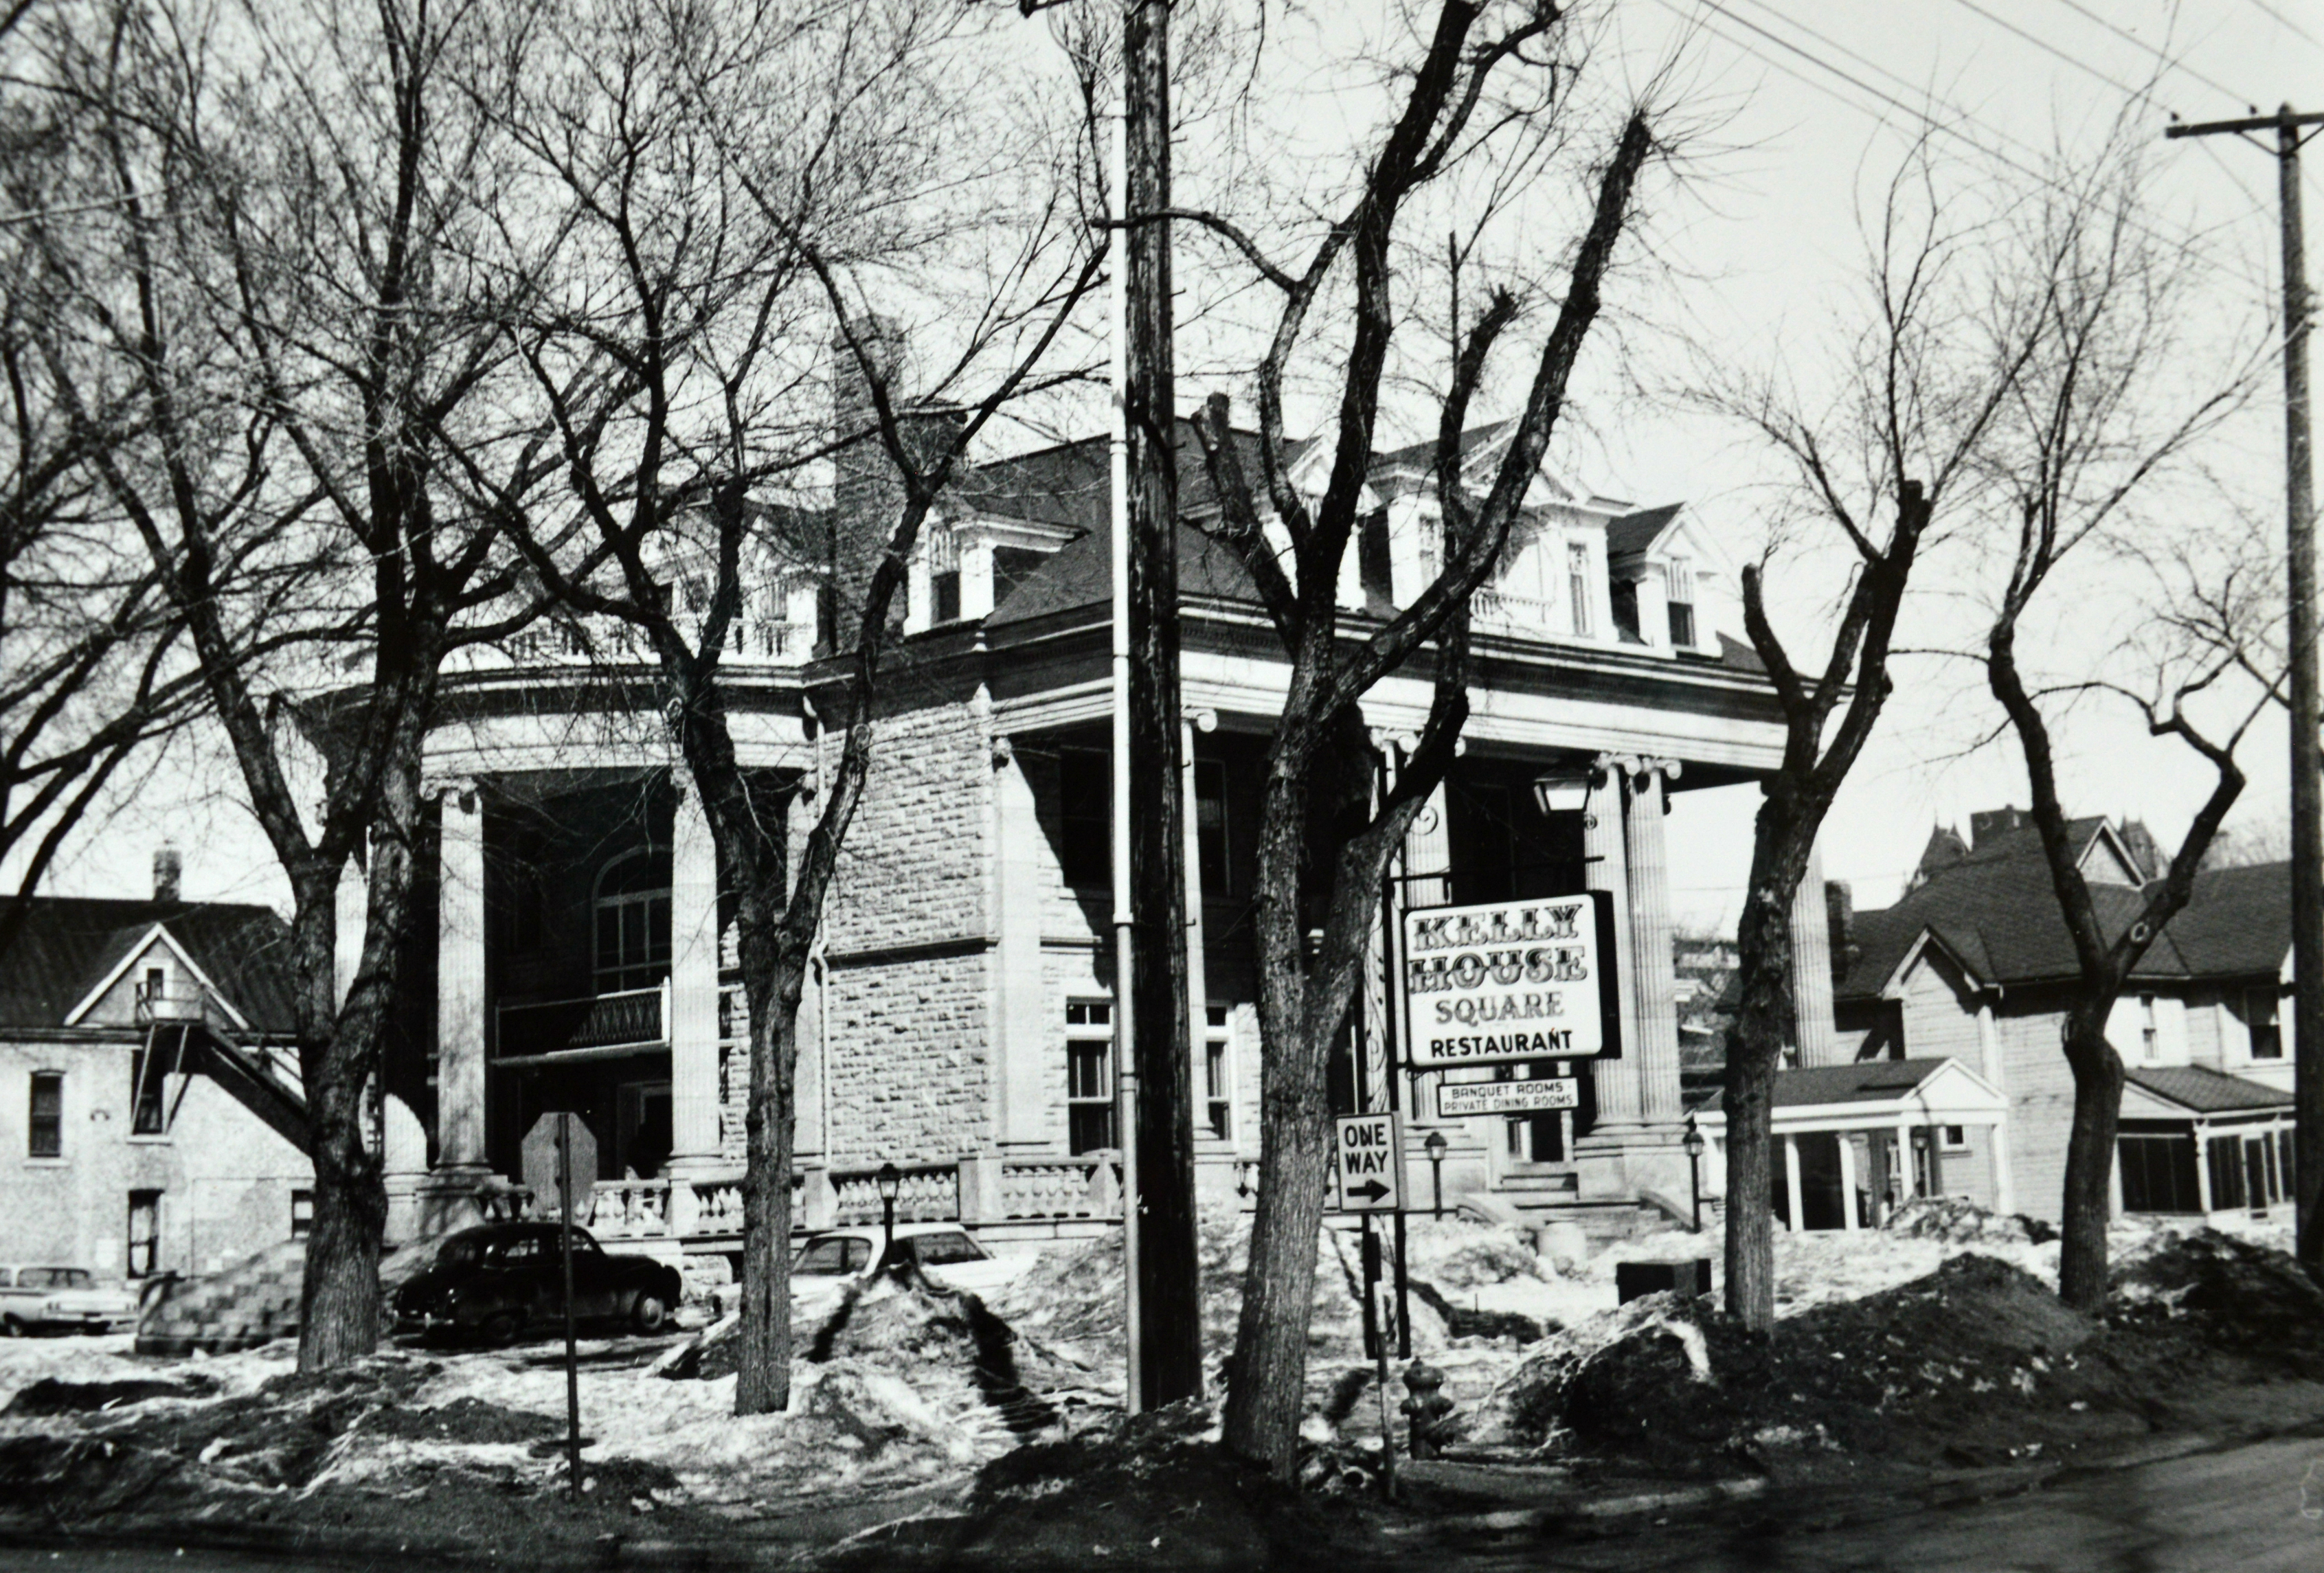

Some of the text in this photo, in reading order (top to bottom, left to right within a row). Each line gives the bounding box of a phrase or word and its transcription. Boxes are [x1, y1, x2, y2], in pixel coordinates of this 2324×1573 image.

[1413, 903, 1583, 952] KELLY
[1408, 945, 1588, 994] HOUSE
[1435, 991, 1565, 1027] SQUARE
[1430, 1030, 1572, 1058] RESTAURANT
[1444, 1094, 1573, 1111] PRIVATE DINING ROOMS
[1452, 1081, 1564, 1099] BANQUET ROOMS
[1344, 1123, 1387, 1147] ONE
[1345, 1151, 1388, 1174] WAY
